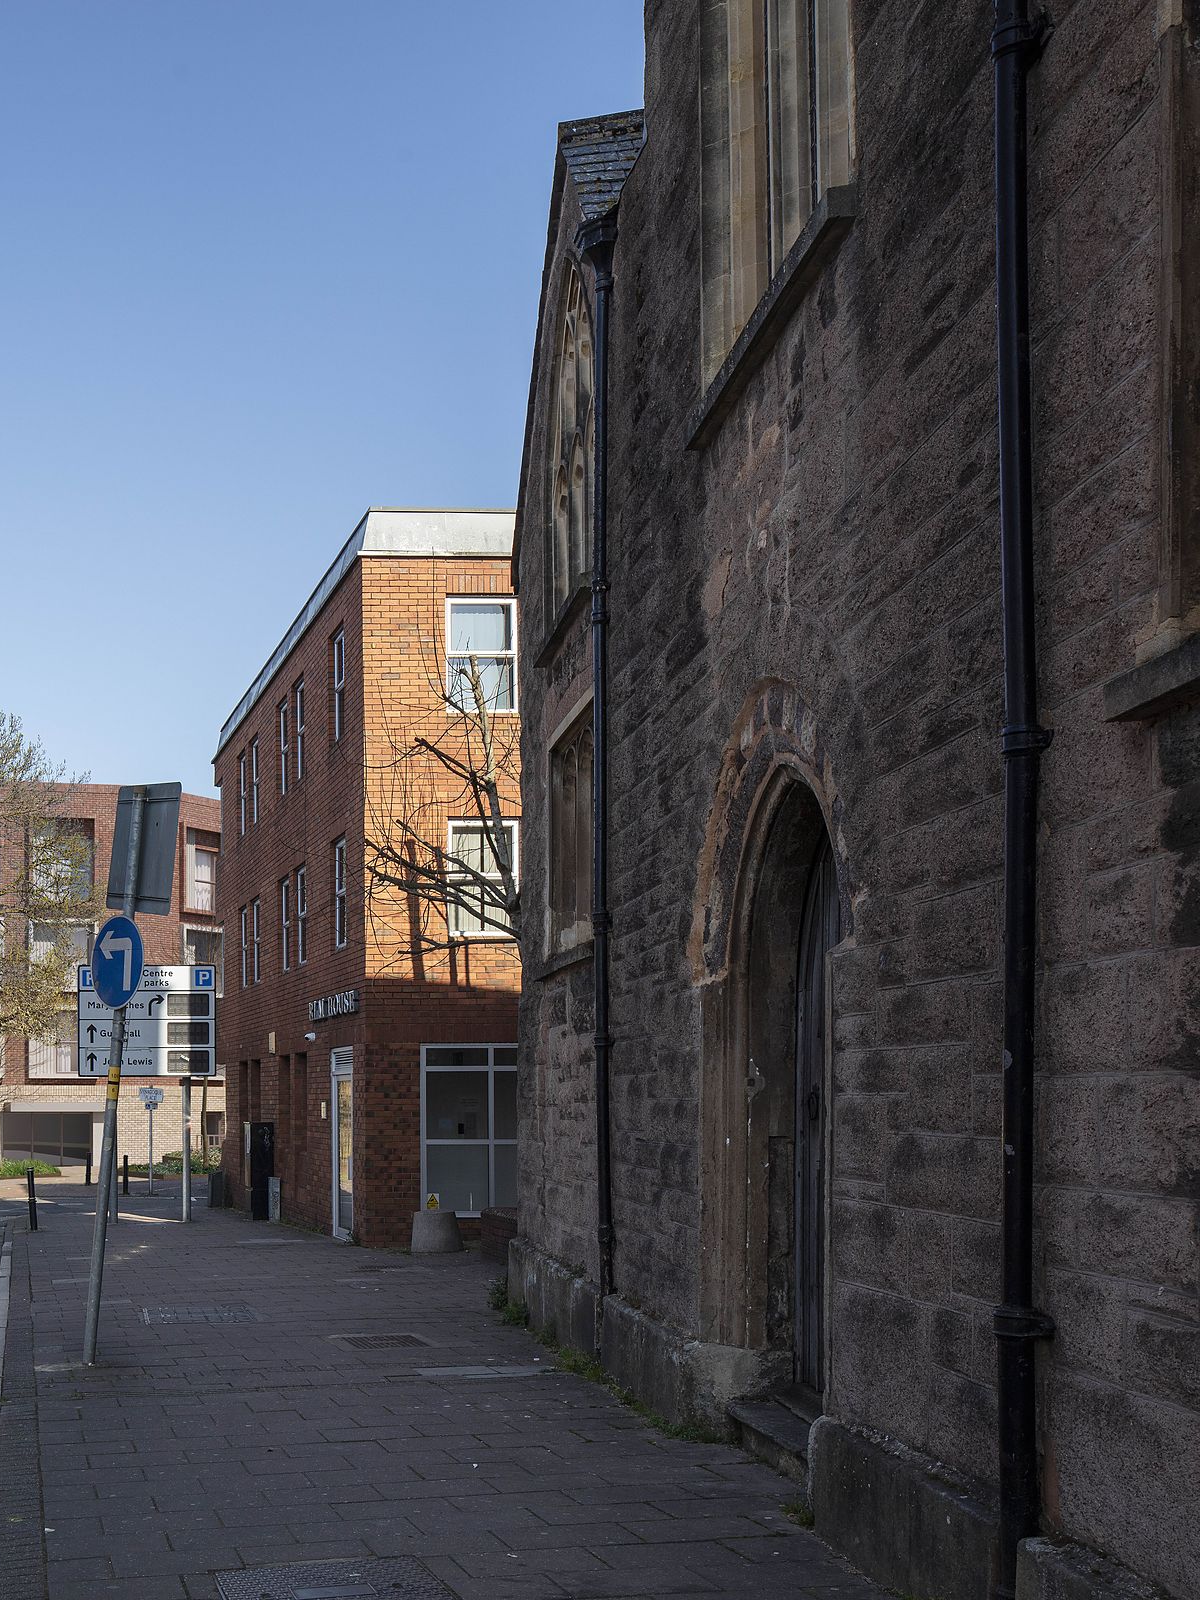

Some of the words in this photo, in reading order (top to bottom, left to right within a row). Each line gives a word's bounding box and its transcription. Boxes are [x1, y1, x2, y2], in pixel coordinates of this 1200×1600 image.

[142, 969, 173, 977] Centre
[144, 979, 169, 987] parks
[127, 1057, 153, 1066] Lewis
